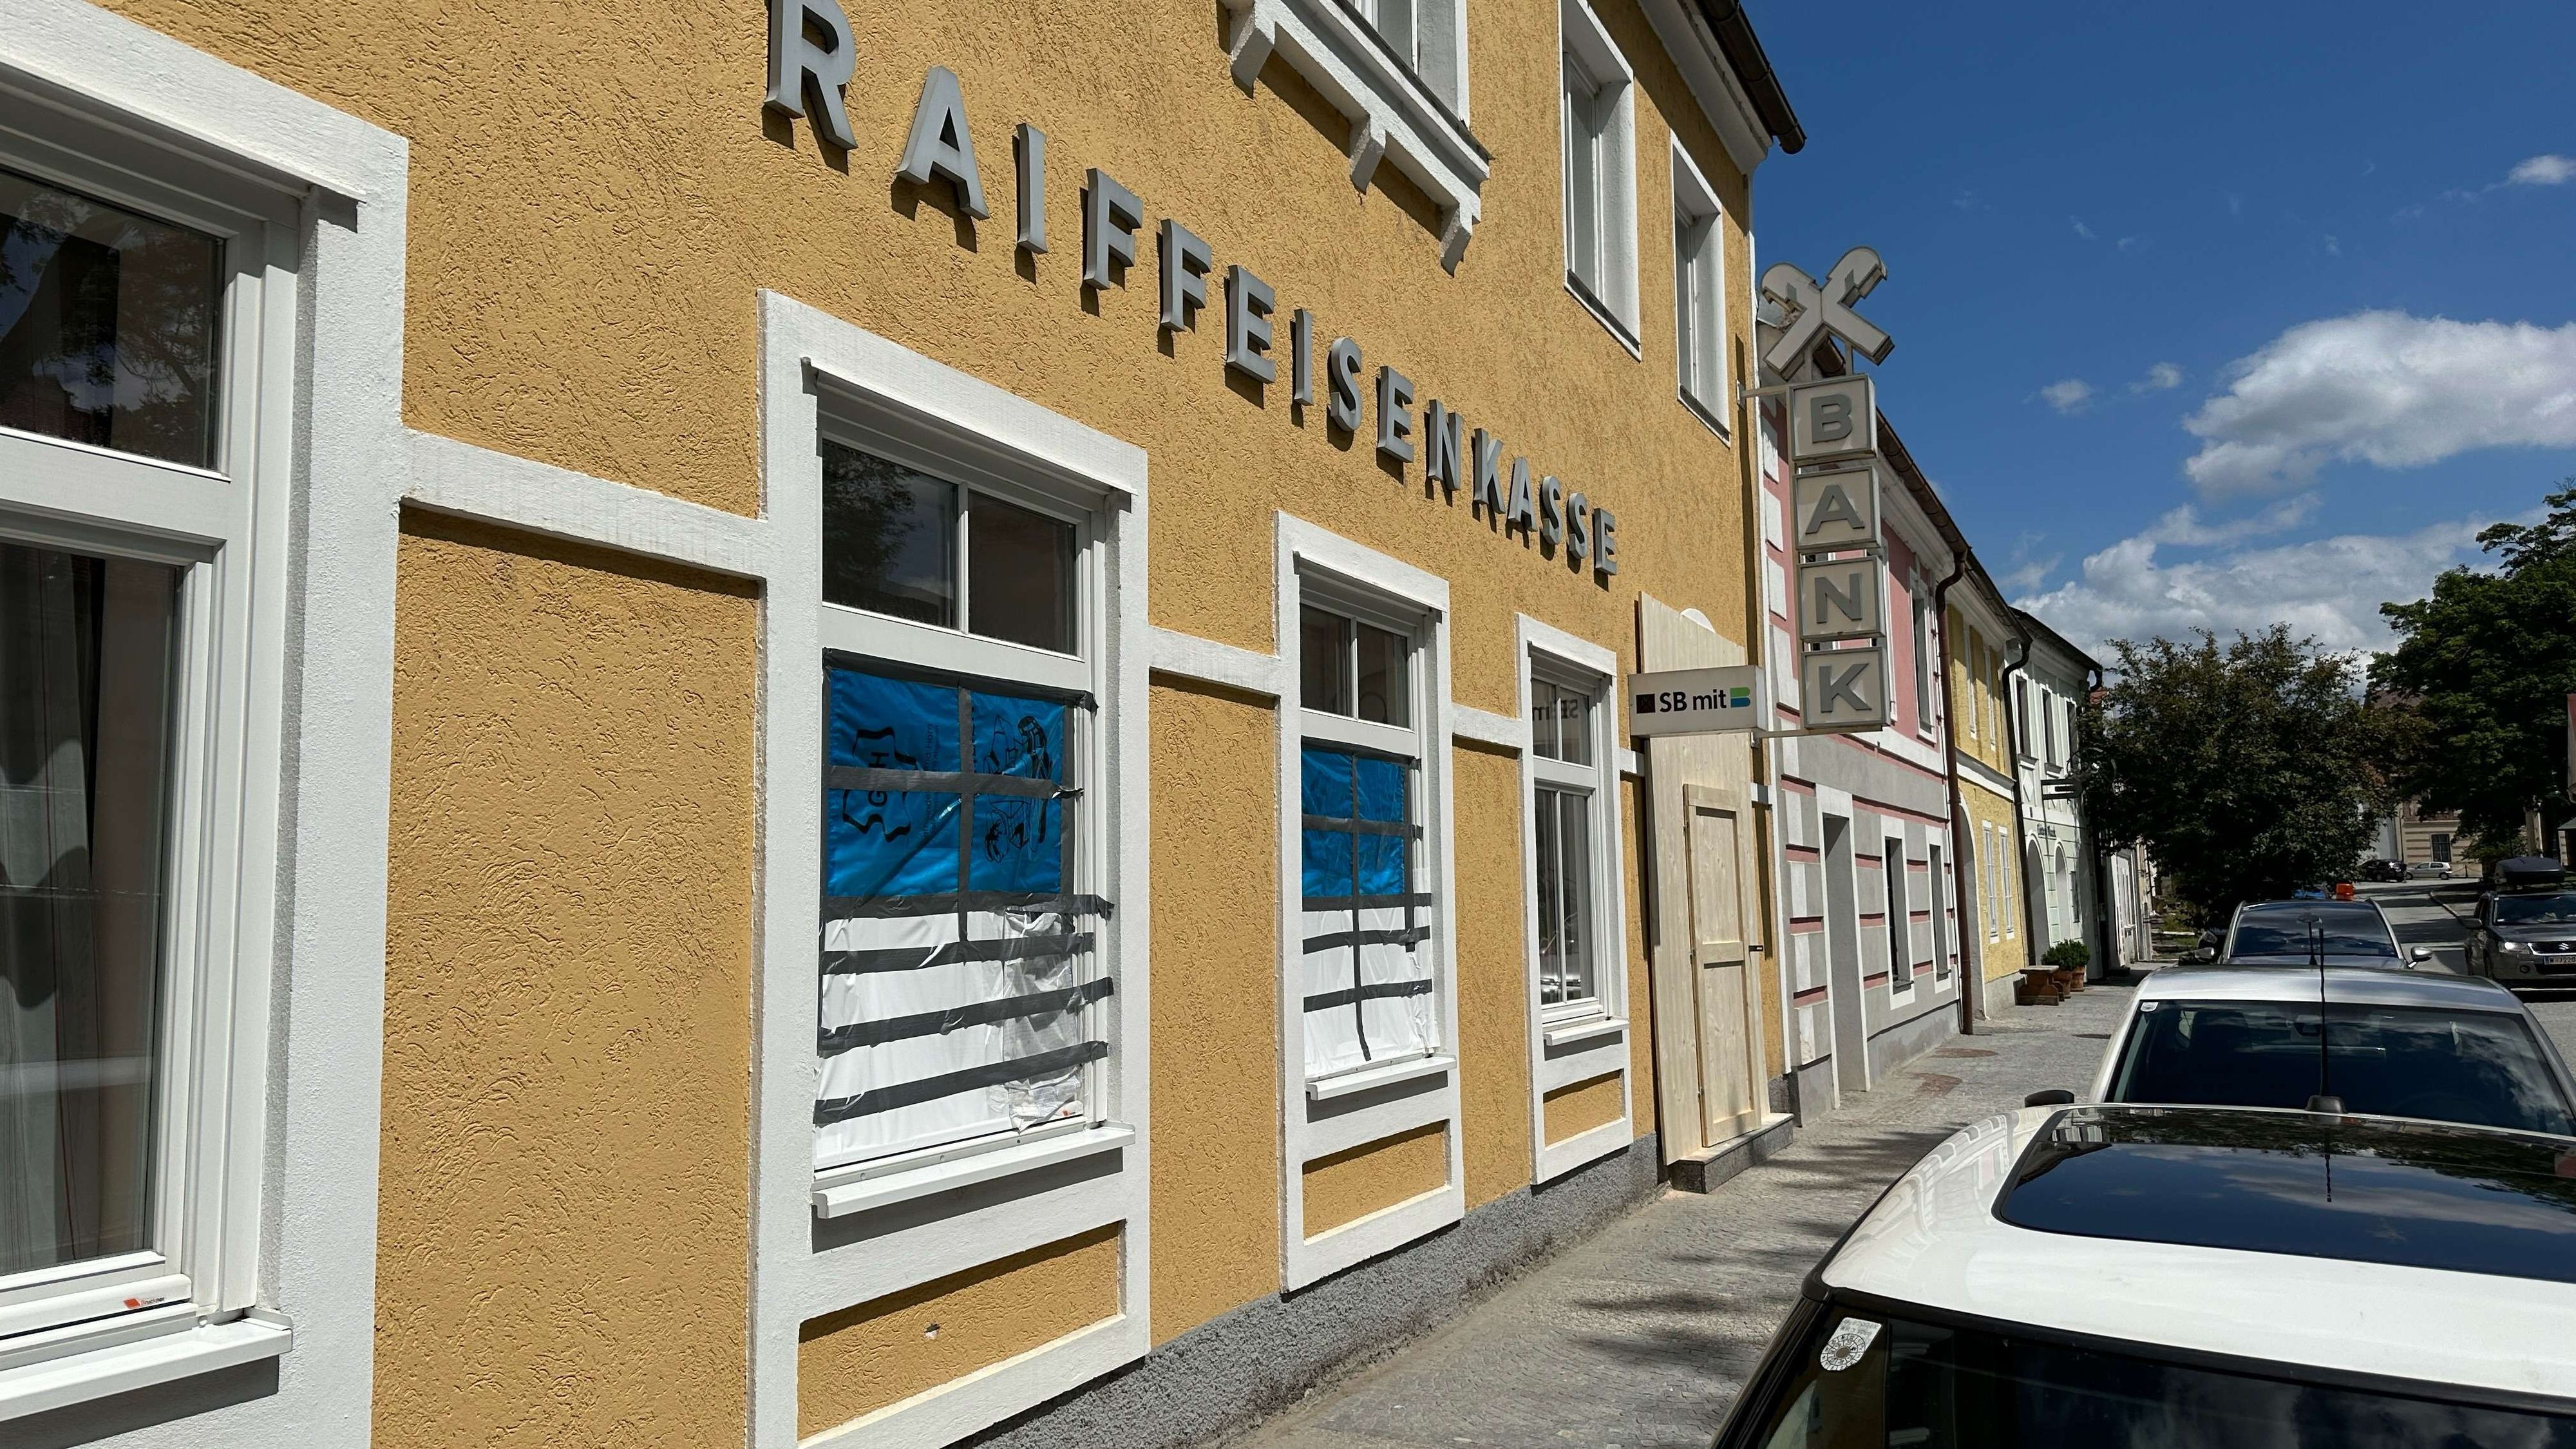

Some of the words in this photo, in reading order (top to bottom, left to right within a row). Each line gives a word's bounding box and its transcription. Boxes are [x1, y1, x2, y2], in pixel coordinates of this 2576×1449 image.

[764, 0, 1617, 576] RAIFFEISENKASSE
[1660, 691, 1687, 712] SB
[1693, 689, 1727, 710] mit
[1806, 393, 1871, 713] BANK
